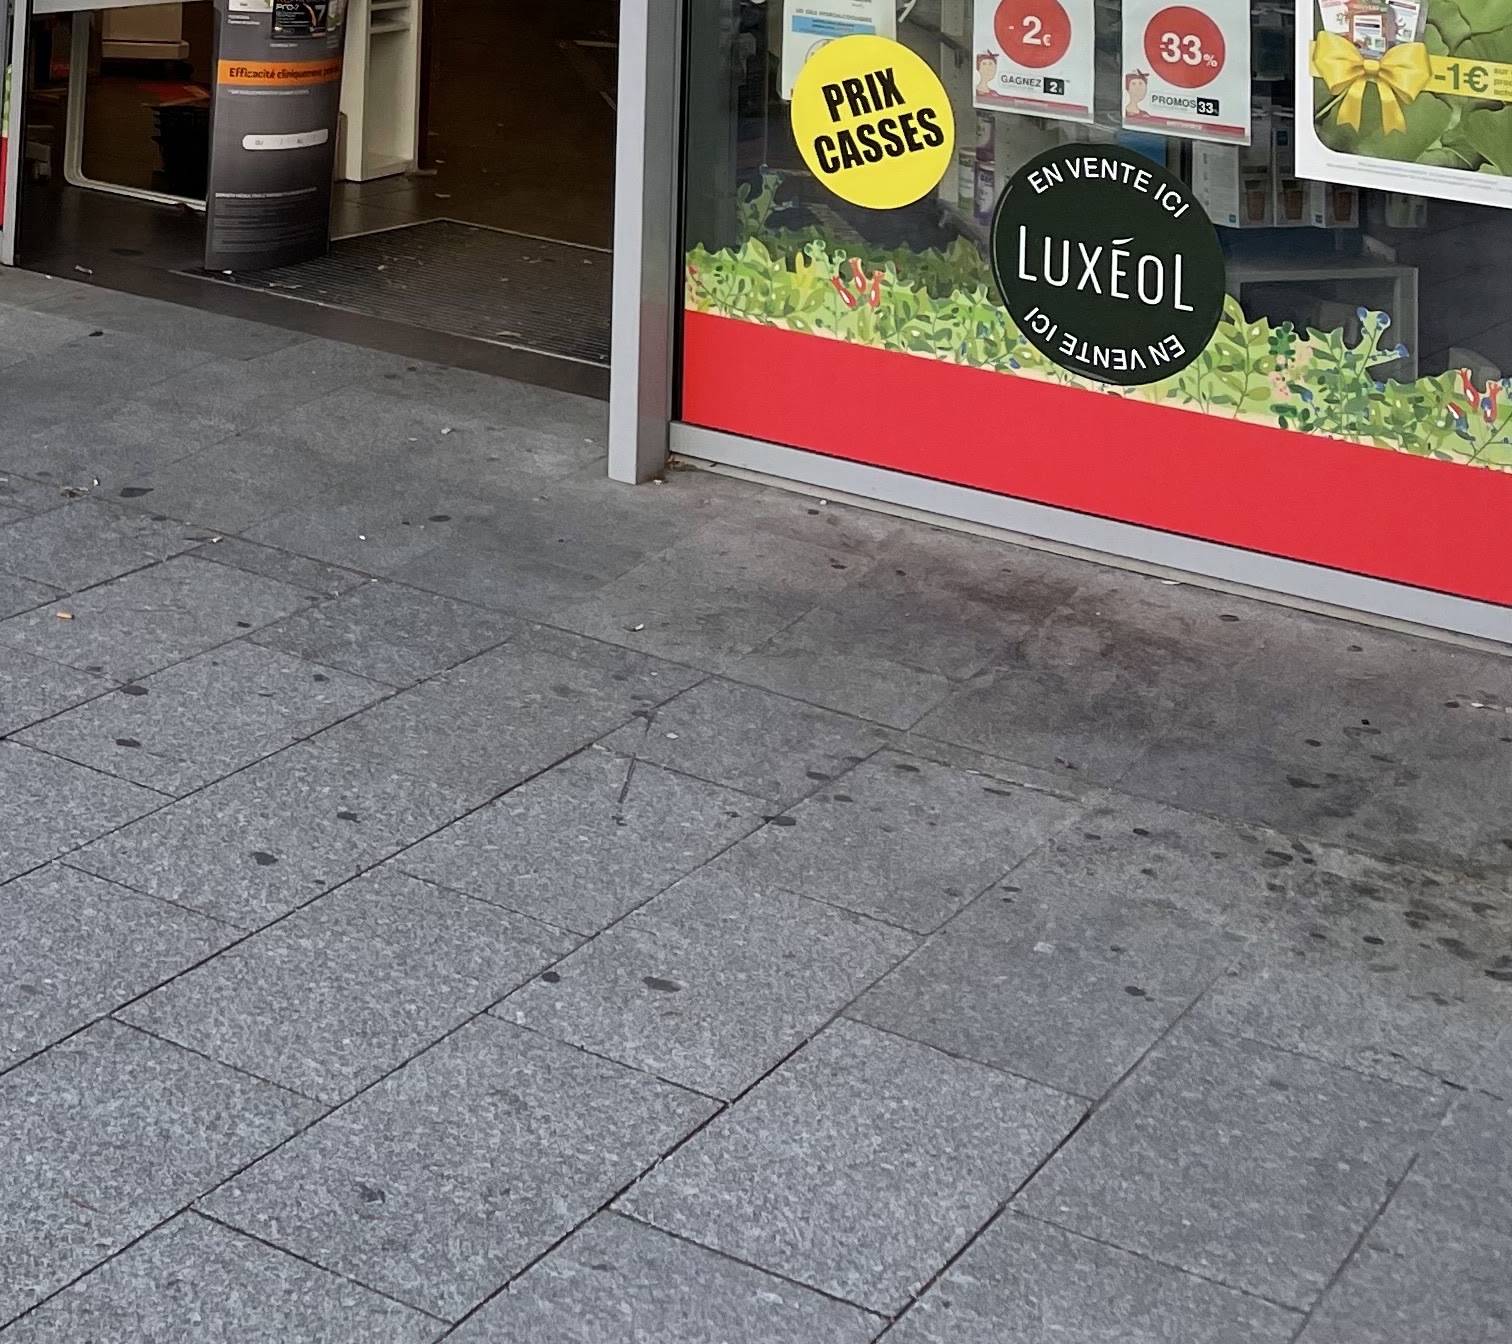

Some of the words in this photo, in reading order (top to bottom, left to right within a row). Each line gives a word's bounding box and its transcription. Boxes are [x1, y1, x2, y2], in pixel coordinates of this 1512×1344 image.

[229, 67, 276, 79] Efficacité
[1000, 74, 1041, 88] GAGNEZ
[1434, 62, 1488, 93] -1€
[821, 67, 905, 124] PRIX
[1152, 95, 1196, 109] PROMOS
[1198, 101, 1217, 114] 33
[813, 108, 945, 175] CASSES
[1027, 162, 1063, 195] EN
[1065, 157, 1153, 194] VENTE
[1153, 183, 1190, 218] ICI
[1018, 225, 1194, 312] LUXÉOL
[1023, 307, 1058, 342] ICI
[1059, 332, 1147, 370] VENTE
[1147, 334, 1186, 367] EN
